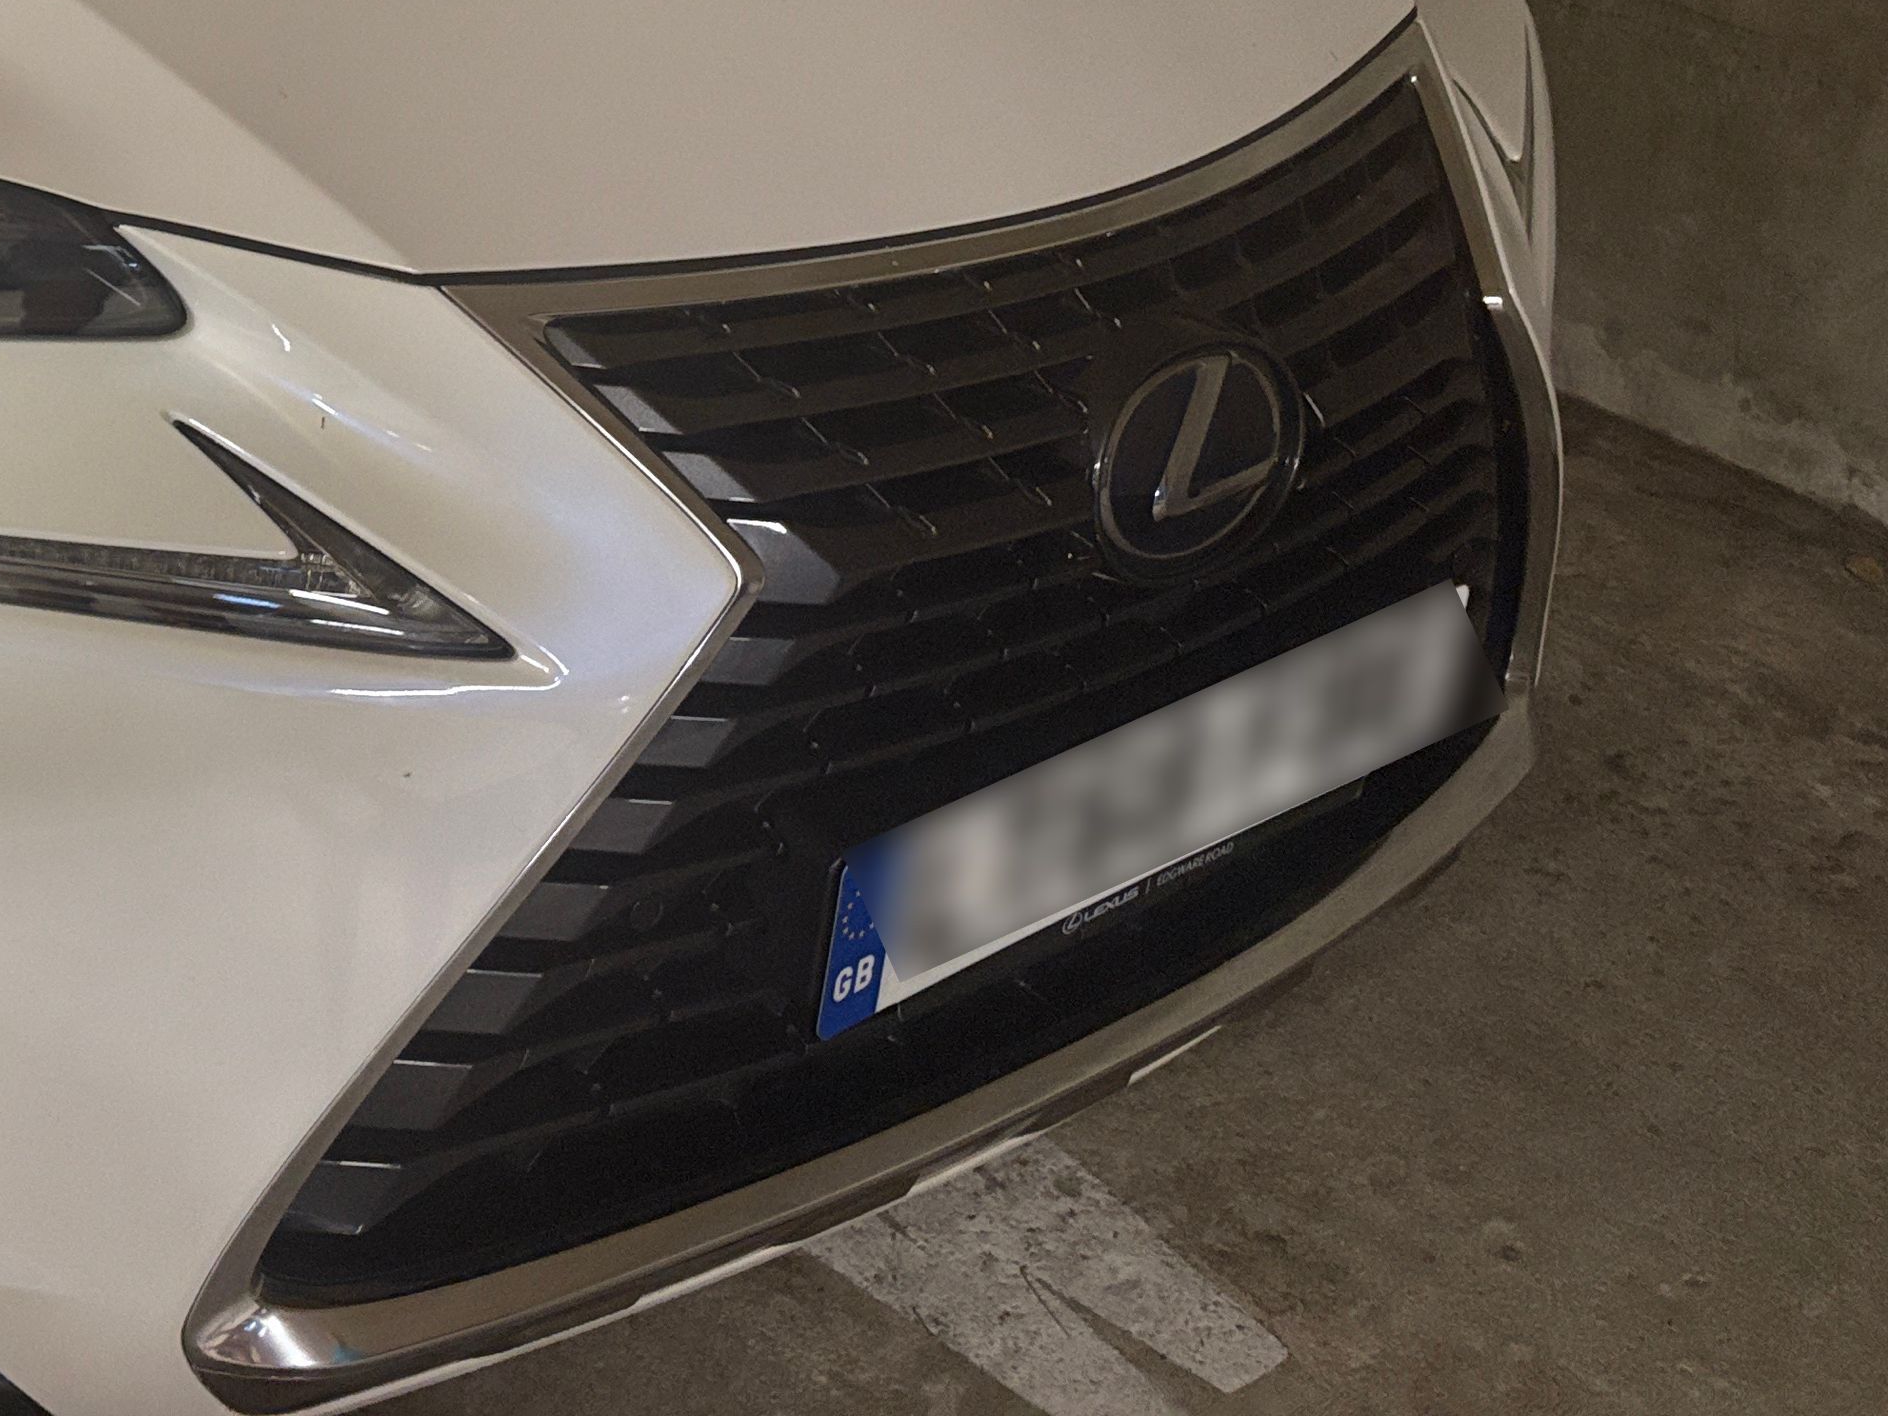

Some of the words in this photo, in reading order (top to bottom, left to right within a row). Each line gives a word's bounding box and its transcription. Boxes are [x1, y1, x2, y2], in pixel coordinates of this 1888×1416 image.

[1084, 886, 1139, 922] LEXUS
[1156, 853, 1205, 886] EDGWARE
[1205, 841, 1234, 865] ROAD
[833, 954, 875, 1003] GB
